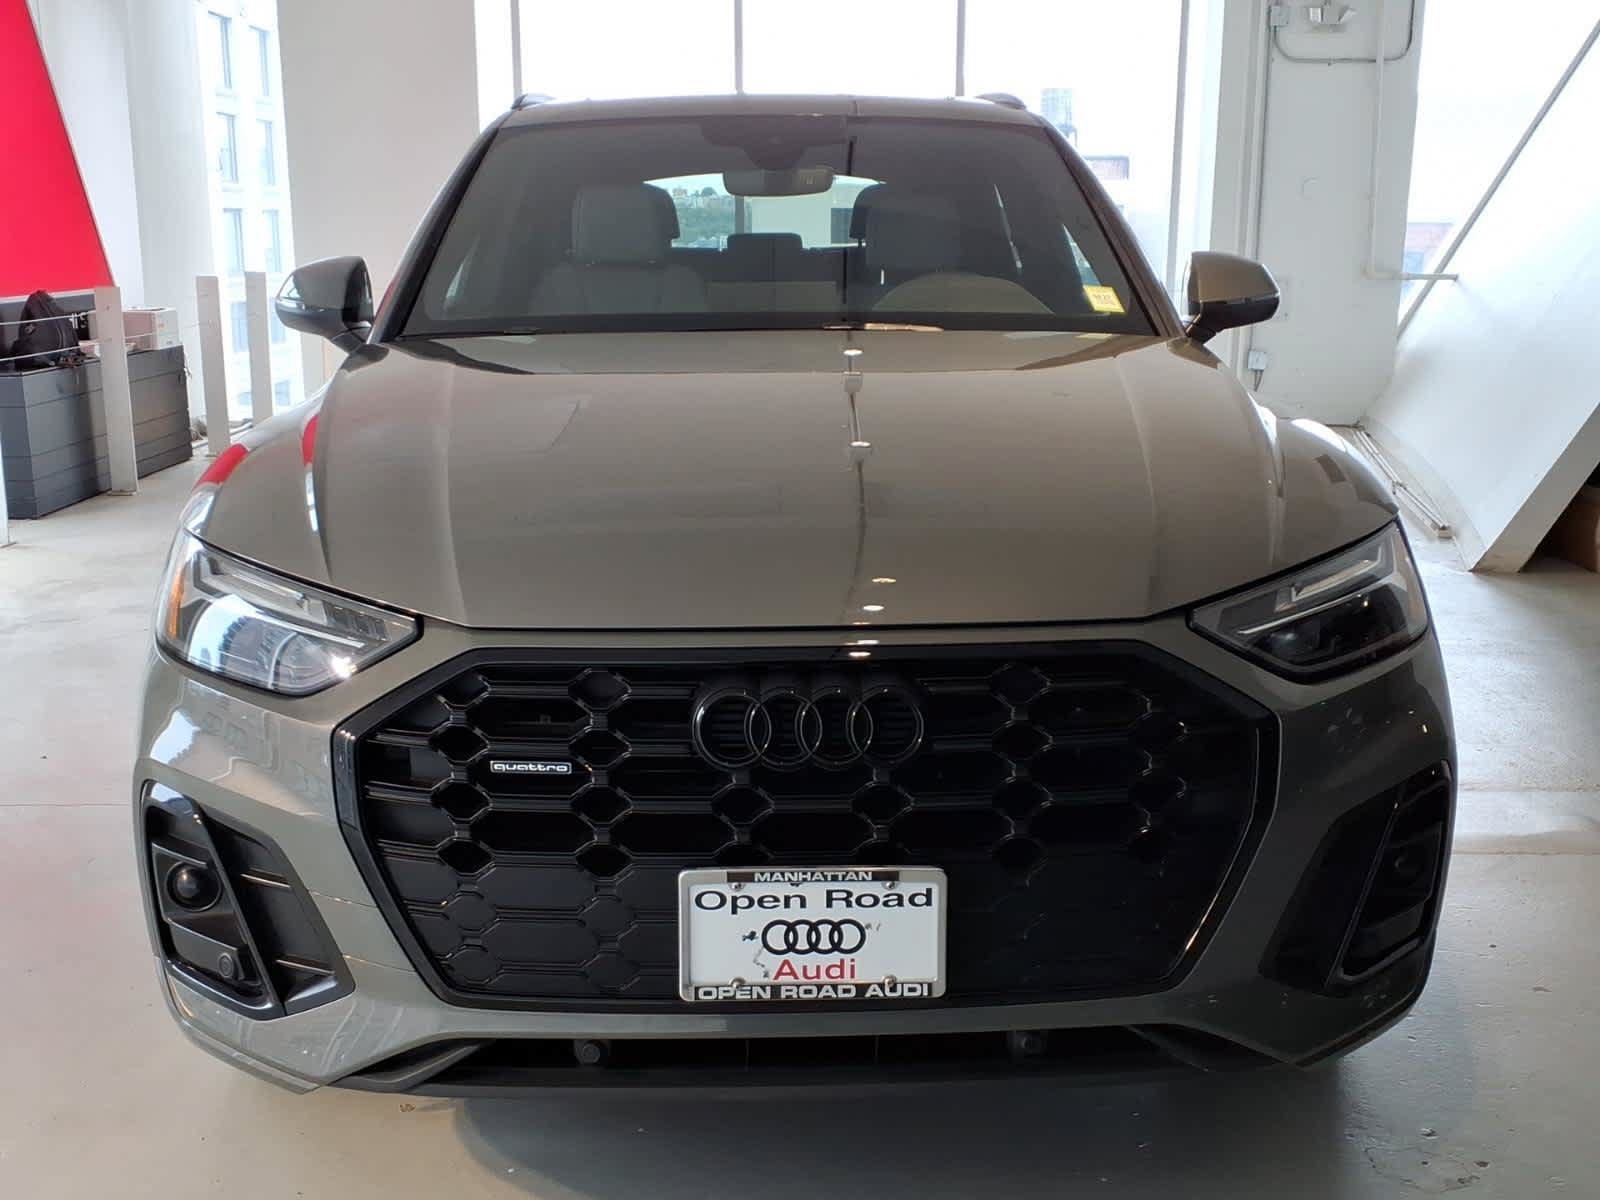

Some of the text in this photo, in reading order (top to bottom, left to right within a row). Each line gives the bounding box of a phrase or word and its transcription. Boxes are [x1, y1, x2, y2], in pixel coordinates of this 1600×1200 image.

[493, 763, 568, 772] quattro
[754, 871, 873, 882] MANHATTAN
[694, 888, 933, 915] Open Road
[772, 958, 856, 980] Audi
[698, 983, 929, 1000] OPEN ROAD AUDI
